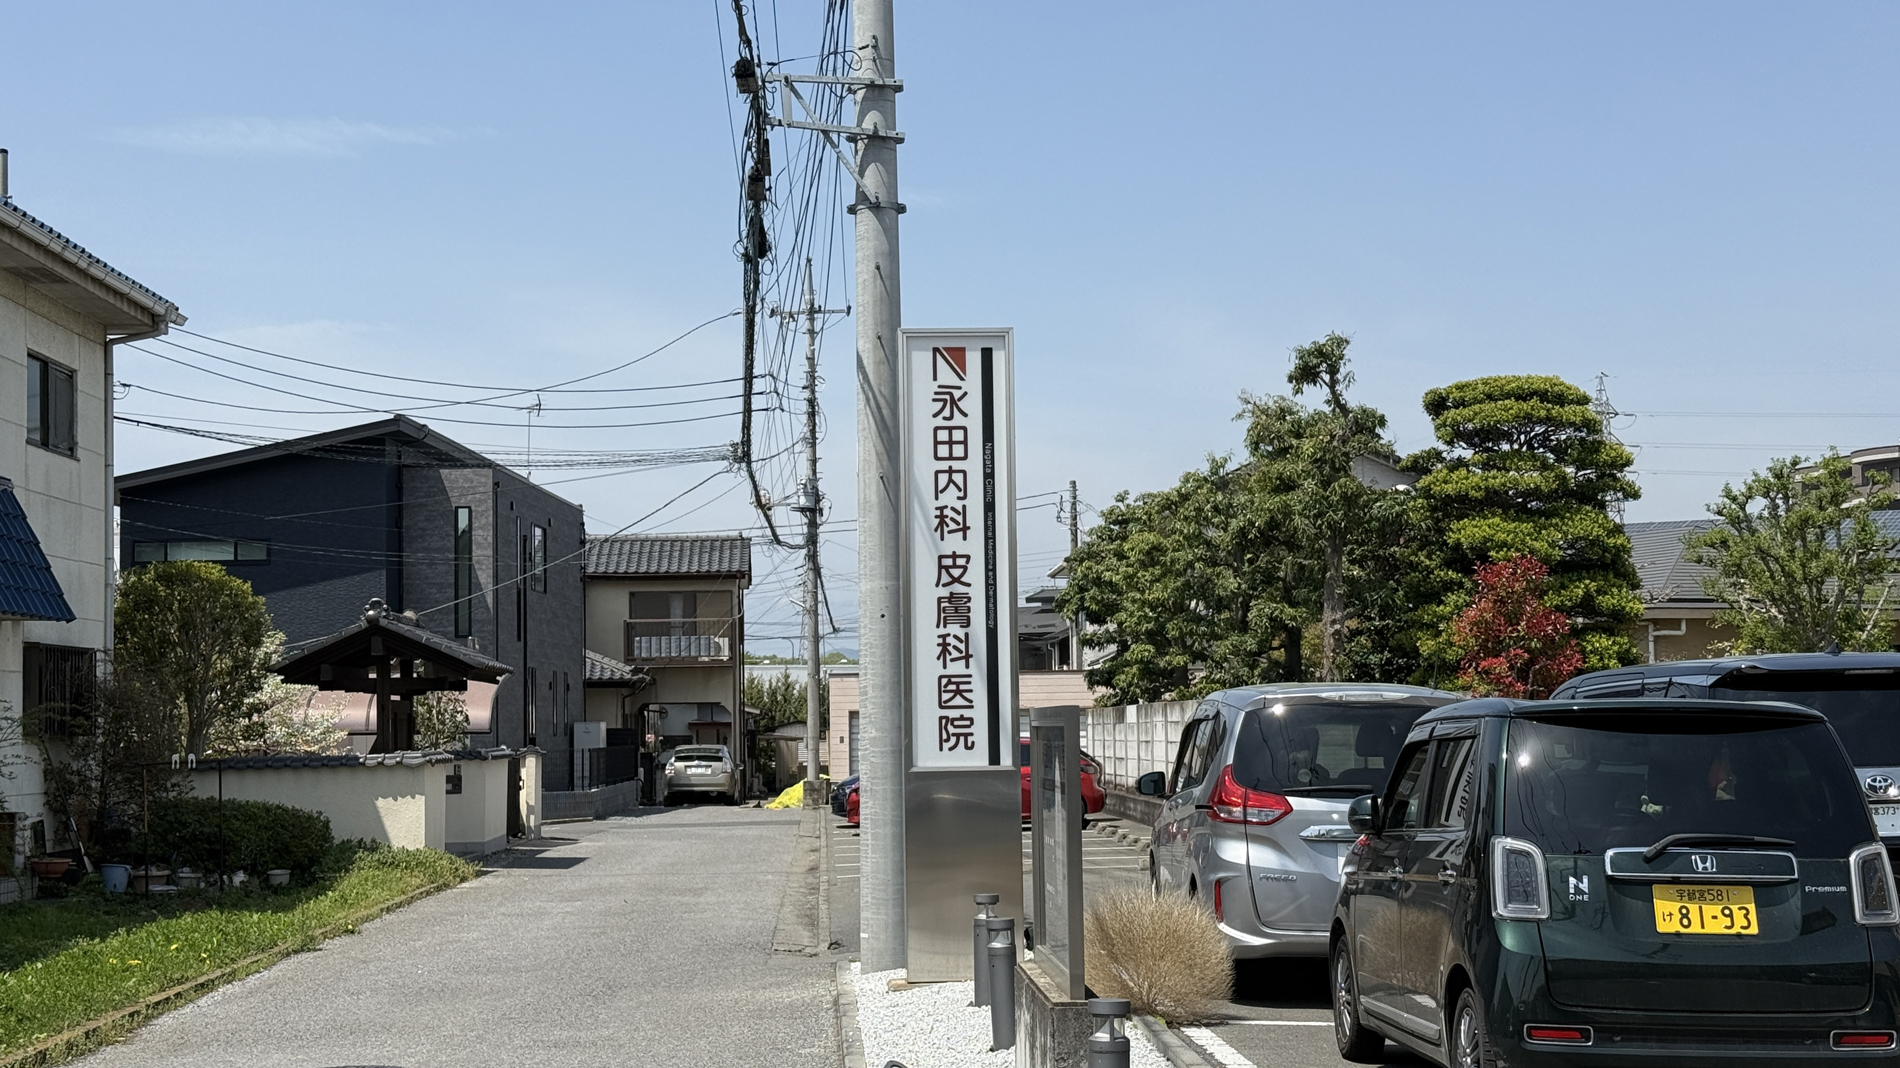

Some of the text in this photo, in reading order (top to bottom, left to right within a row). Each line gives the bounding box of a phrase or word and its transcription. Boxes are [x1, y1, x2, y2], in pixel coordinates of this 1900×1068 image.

[984, 442, 993, 473] Nagata
[985, 478, 993, 503] Clinic
[987, 585, 995, 629] Dermatology
[1259, 873, 1297, 883] FREED
[1568, 874, 1589, 894] N
[1804, 885, 1848, 893] Premium
[1568, 894, 1590, 902] ONE
[1678, 905, 1751, 930] 81-93
